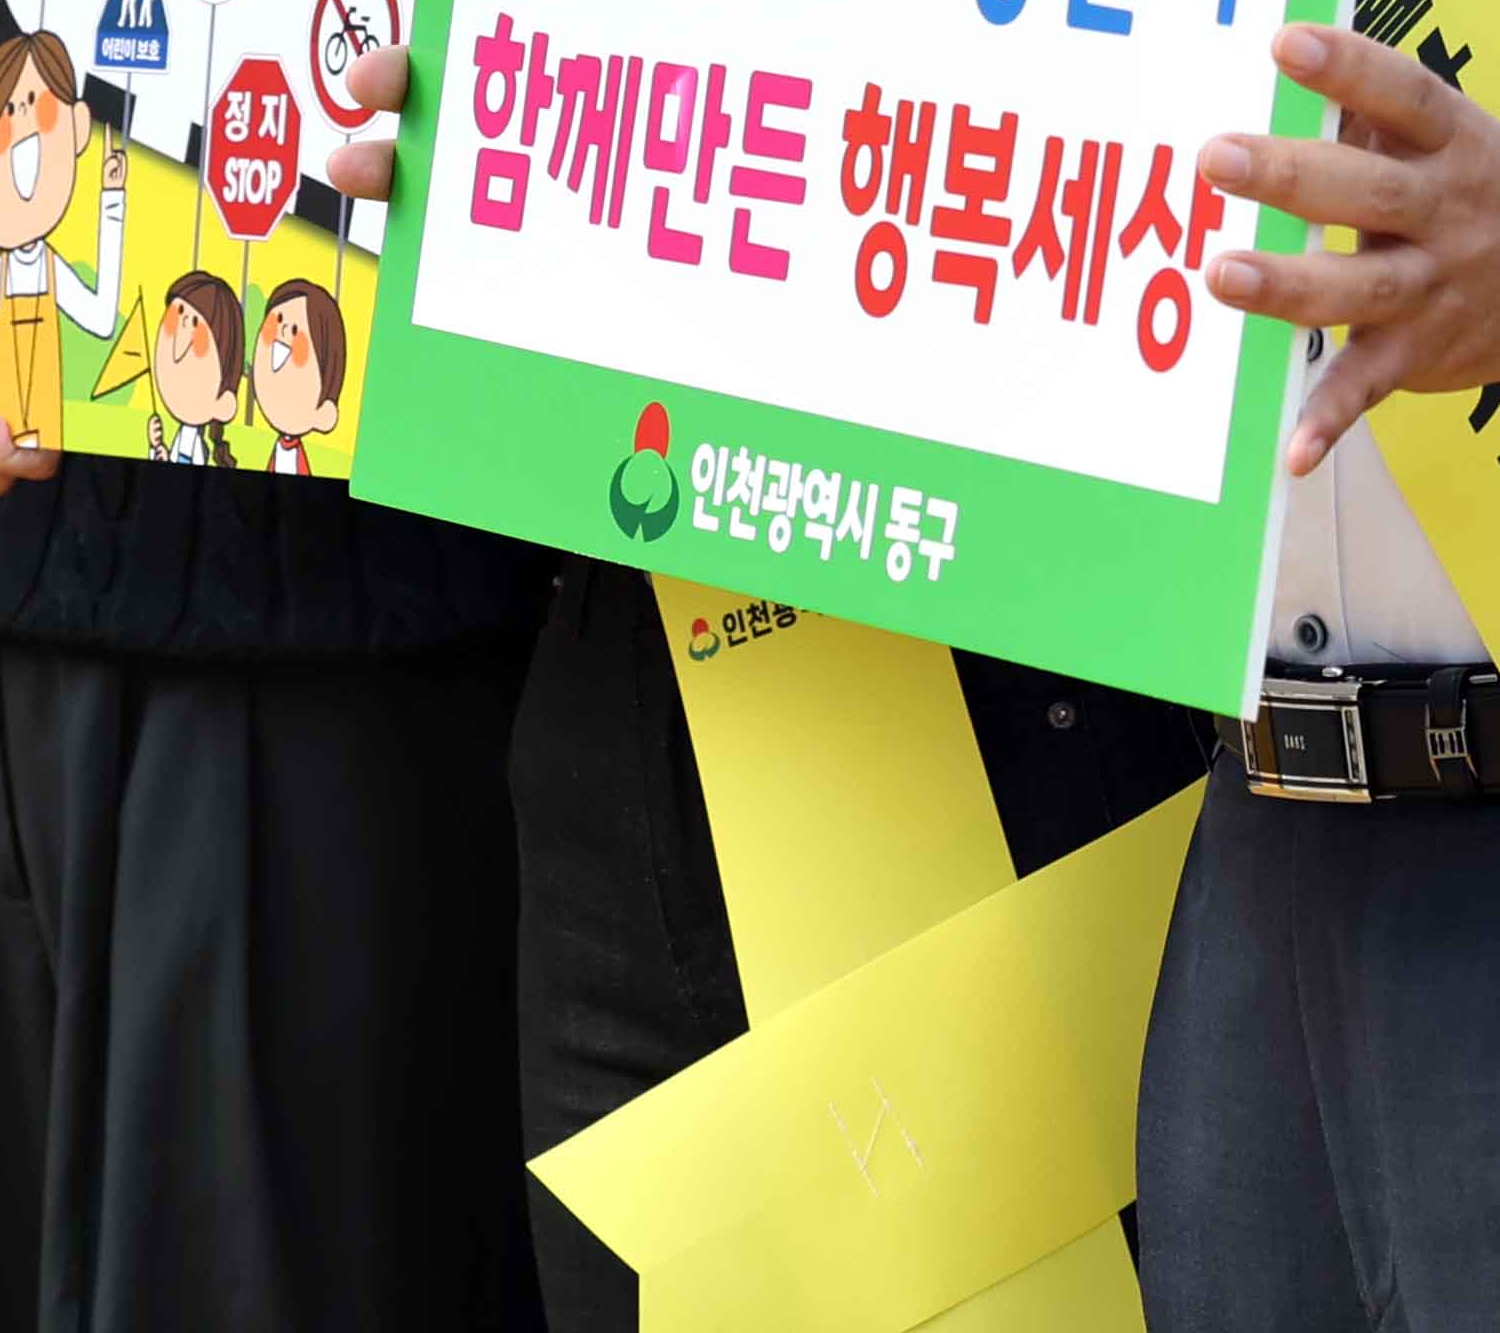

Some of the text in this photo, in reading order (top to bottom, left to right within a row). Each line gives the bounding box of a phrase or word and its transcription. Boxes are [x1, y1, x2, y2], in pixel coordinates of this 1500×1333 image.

[223, 156, 283, 205] STOP
[470, 12, 1226, 374] 함께만든 행복세상
[690, 442, 959, 583] 인천광역시 동구
